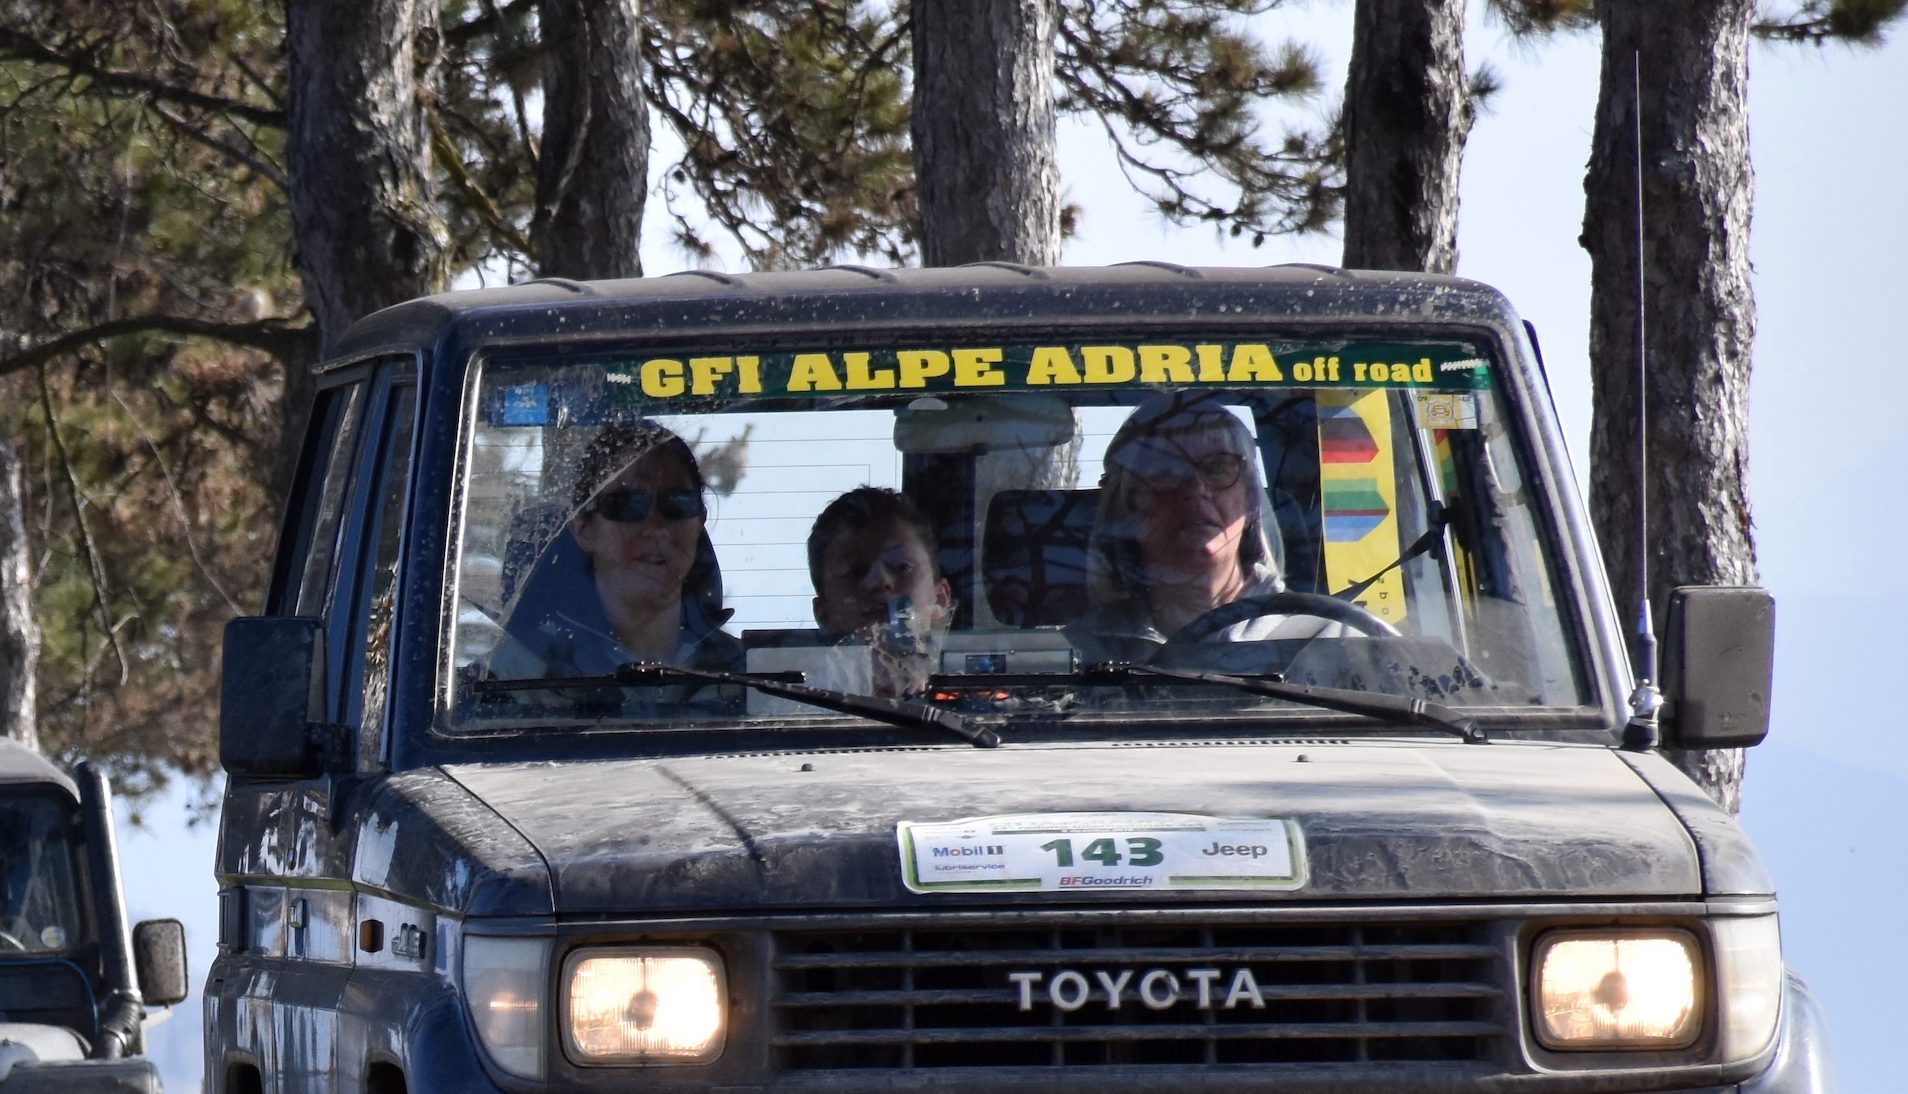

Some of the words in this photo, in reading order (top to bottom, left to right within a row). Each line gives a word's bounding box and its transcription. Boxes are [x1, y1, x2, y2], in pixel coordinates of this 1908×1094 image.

[640, 355, 762, 397] GFI
[787, 348, 1005, 391] ALPE
[1026, 344, 1283, 385] ADRIA
[1293, 357, 1340, 382] off
[1354, 358, 1433, 383] road
[932, 845, 983, 857] Mobil
[1040, 837, 1164, 867] 143
[1202, 842, 1267, 859] Jeep
[1059, 876, 1153, 886] BFGoodrich
[1008, 968, 1266, 1011] TOYOTA
